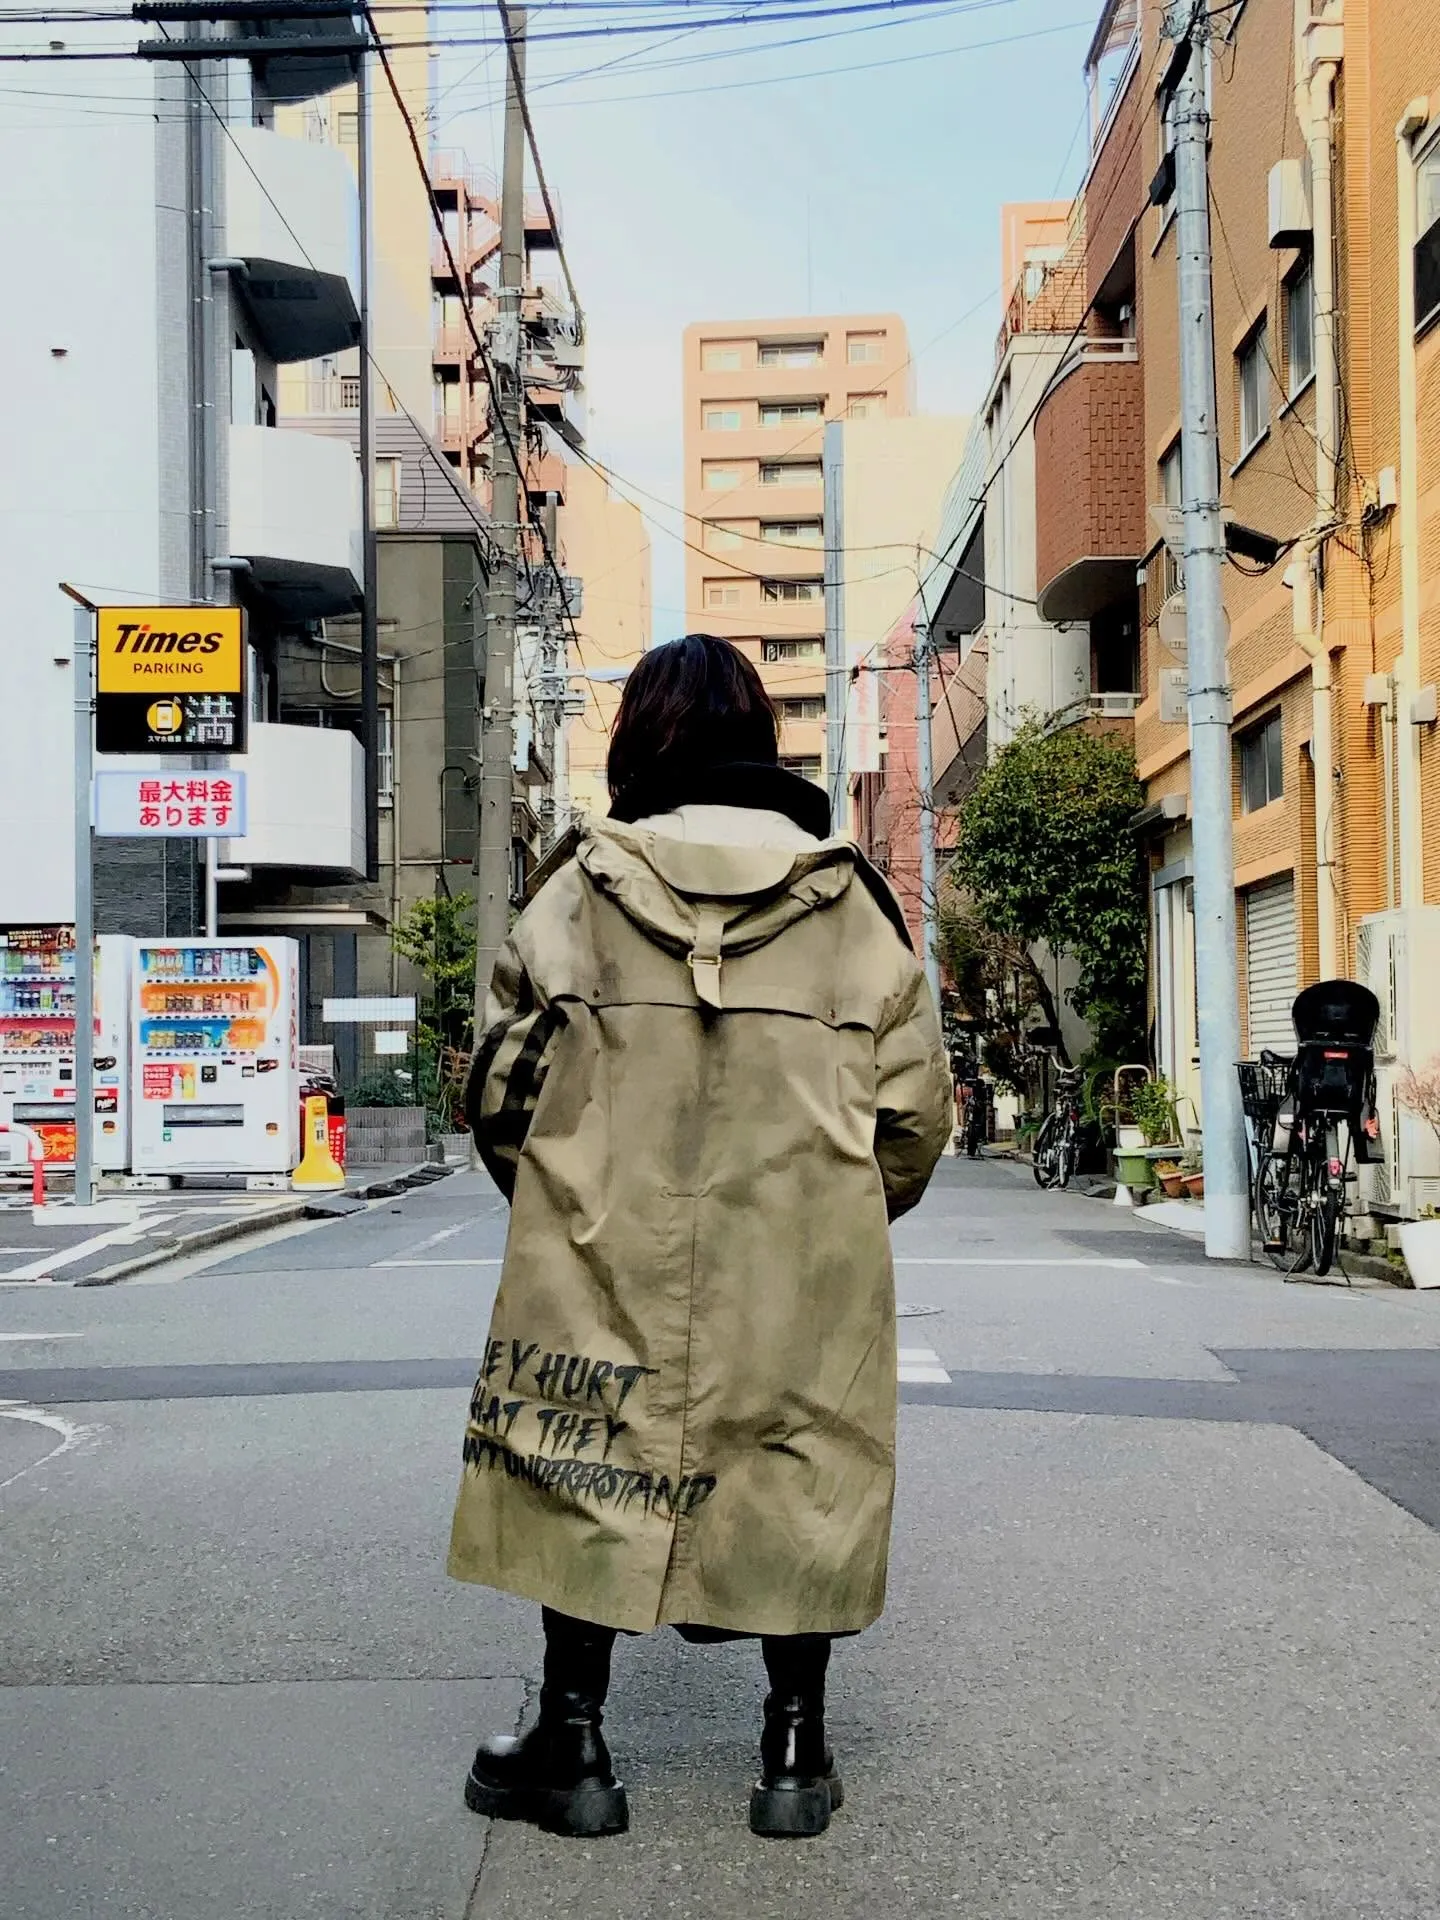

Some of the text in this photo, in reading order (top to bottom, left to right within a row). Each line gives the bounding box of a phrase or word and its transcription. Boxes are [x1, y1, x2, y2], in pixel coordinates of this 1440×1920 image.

[114, 623, 224, 654] Times
[133, 662, 204, 674] PARKING
[138, 780, 233, 803] 最大料金
[138, 806, 233, 827] あります
[535, 1353, 660, 1413] HURT
[537, 1408, 630, 1460] THEY
